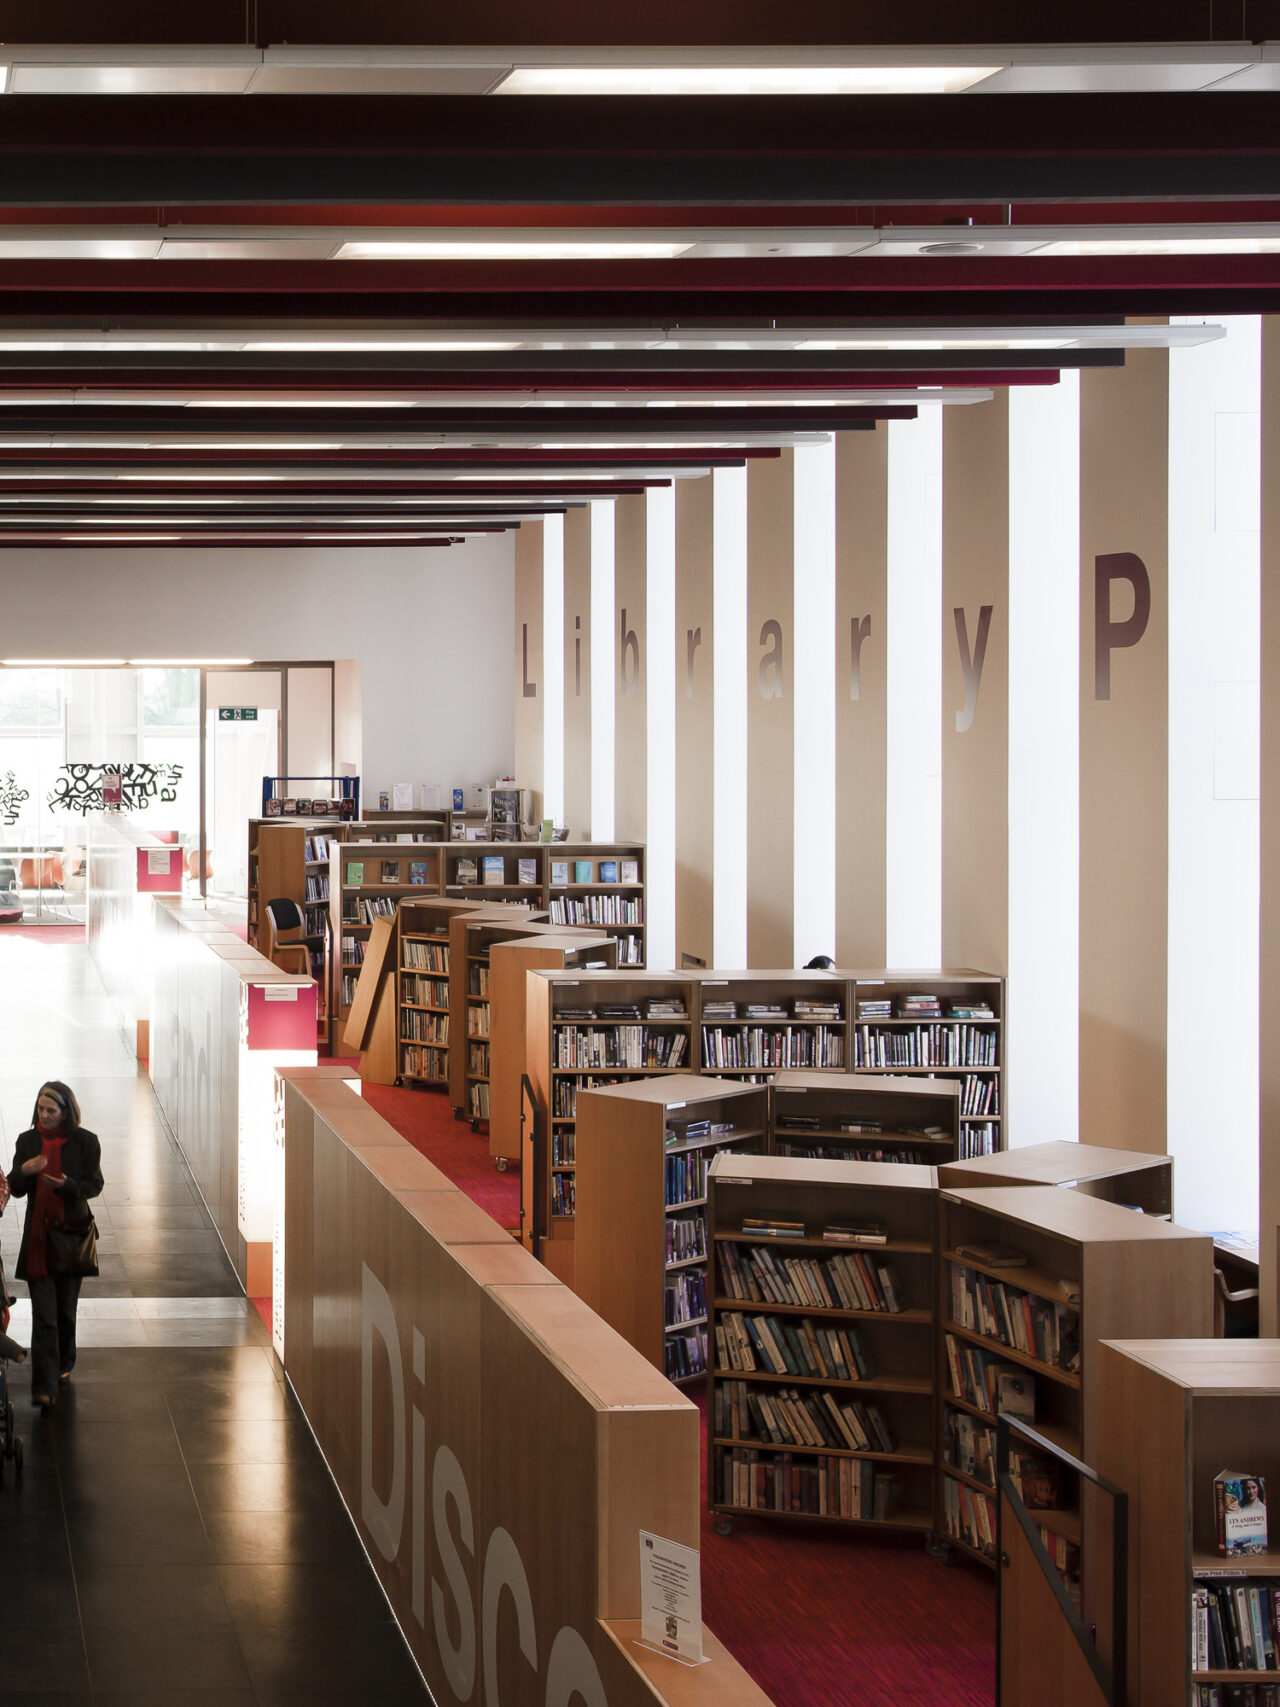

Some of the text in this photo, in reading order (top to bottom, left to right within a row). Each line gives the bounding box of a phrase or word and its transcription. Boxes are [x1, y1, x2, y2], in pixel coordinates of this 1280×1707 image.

[522, 604, 994, 733] Library
[361, 1261, 608, 1707] Disc
[1240, 1515, 1265, 1524] ANDREWS
